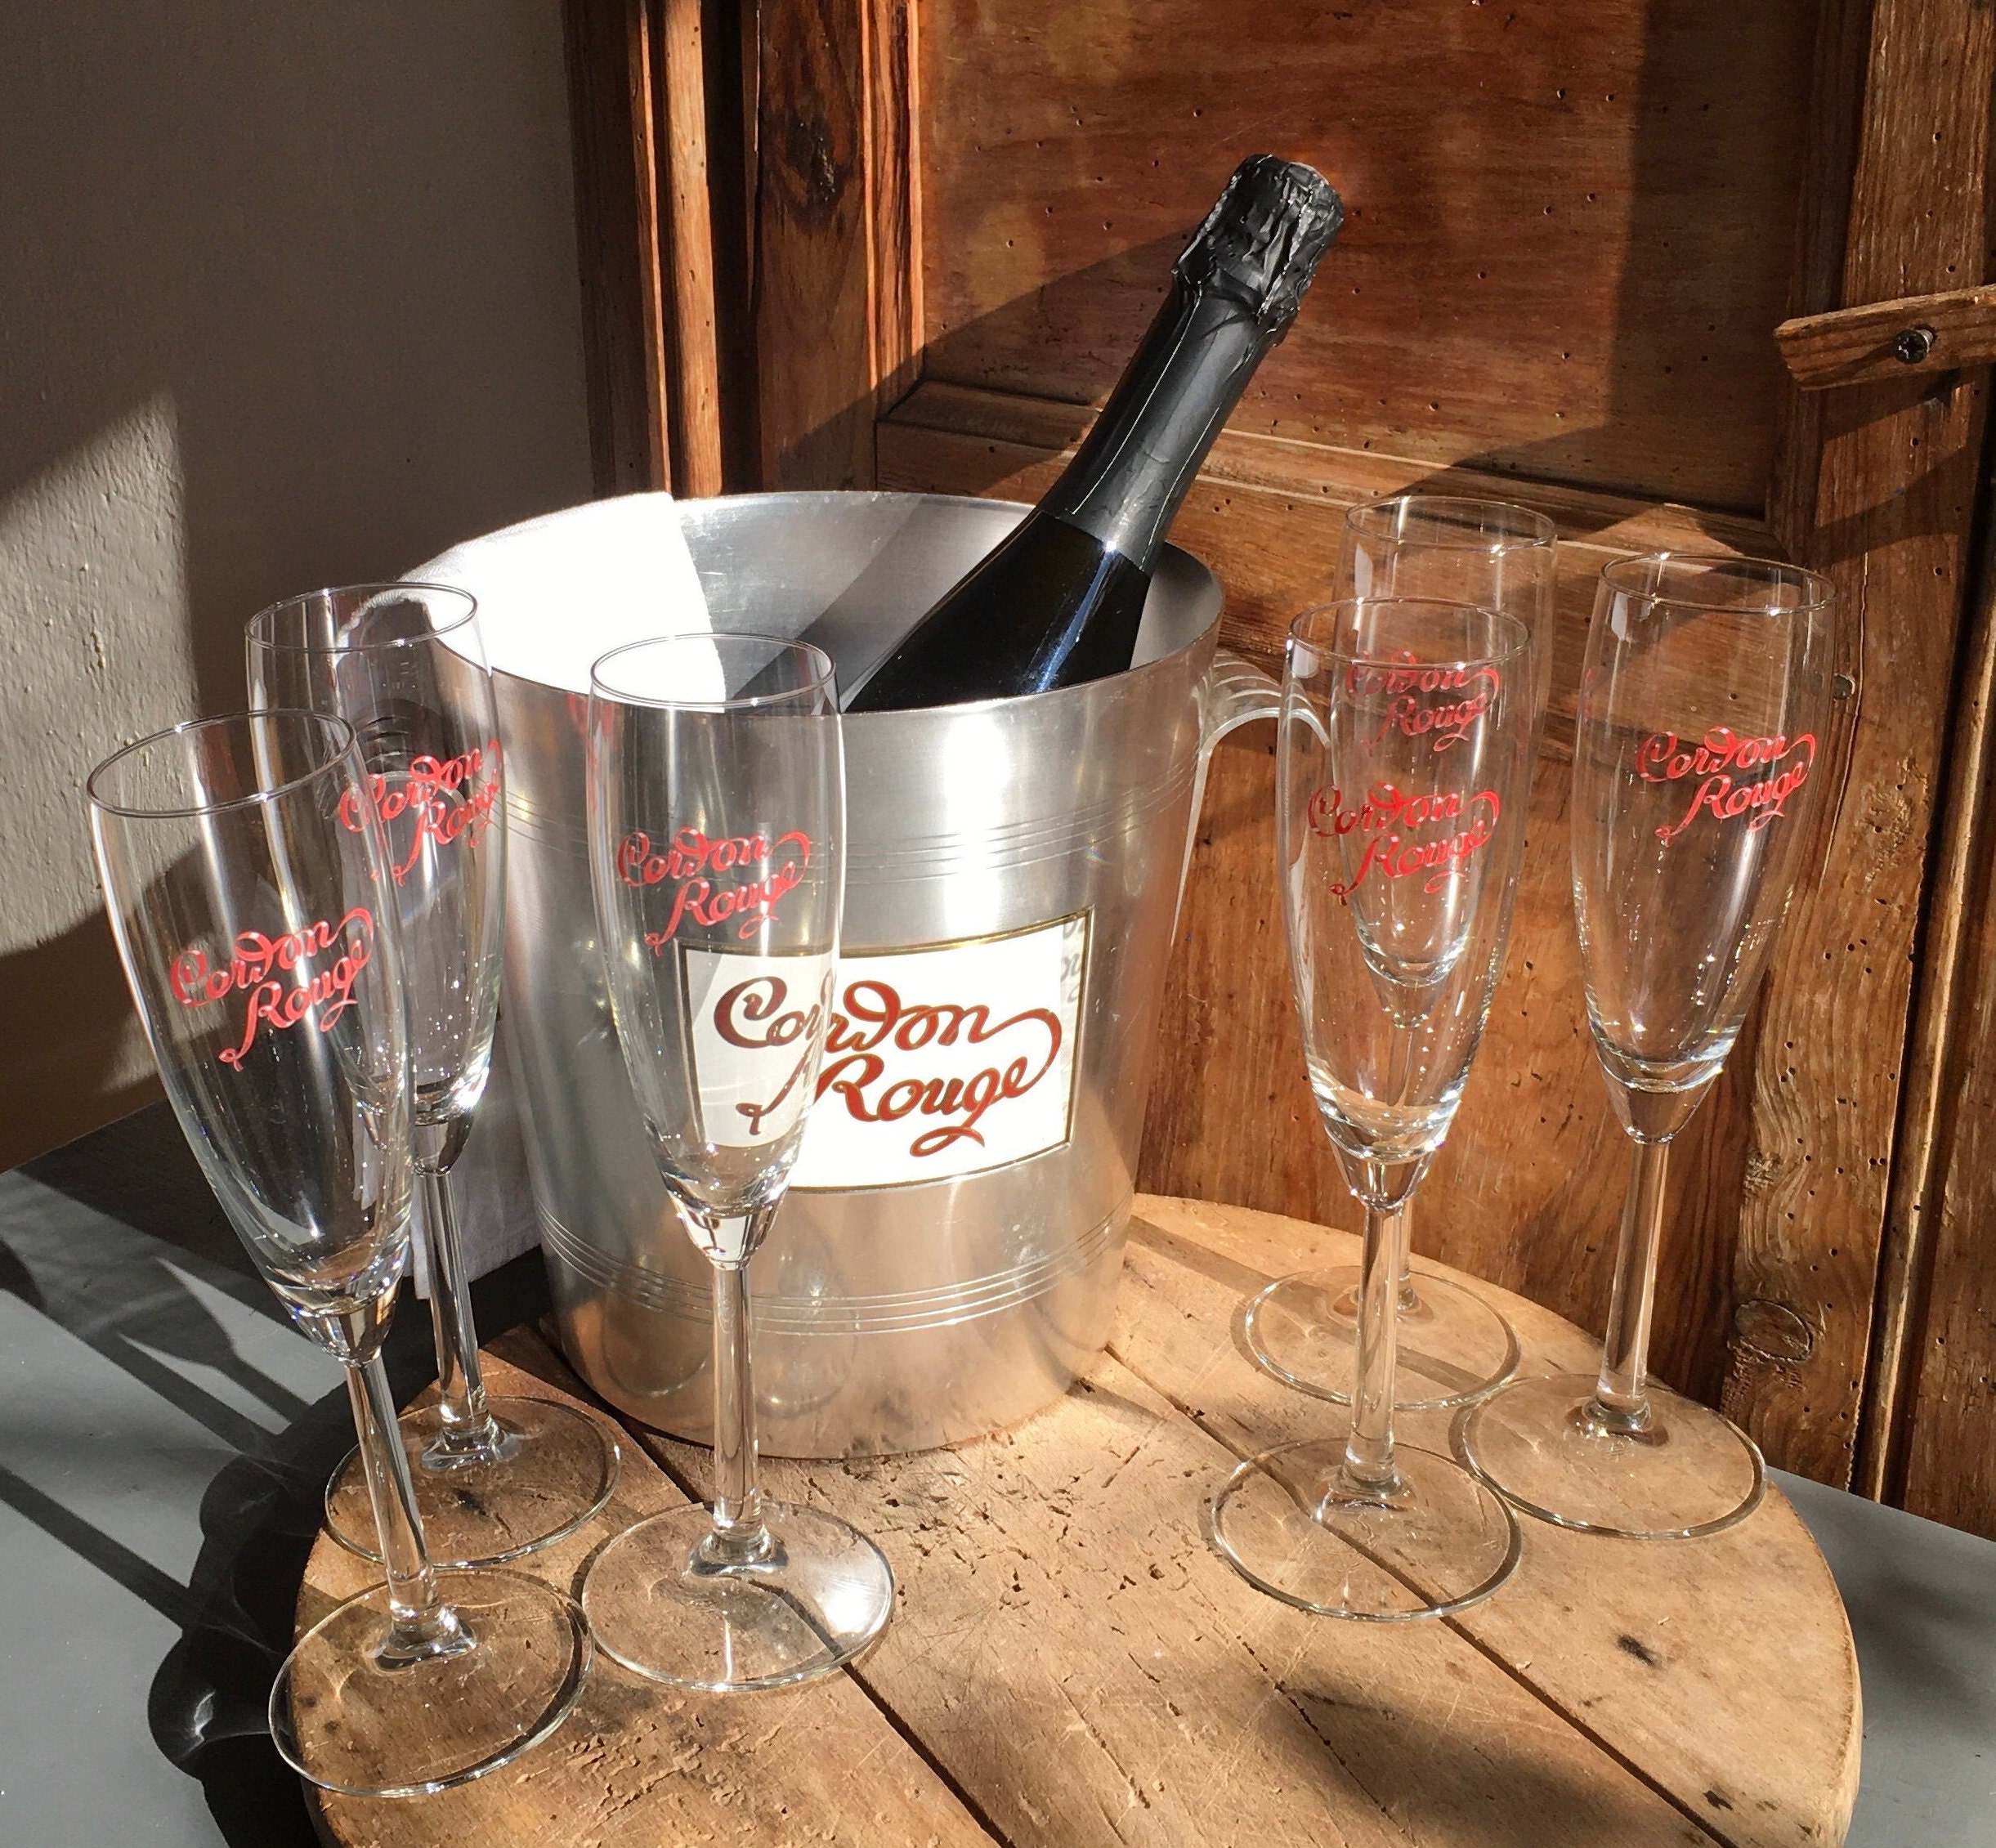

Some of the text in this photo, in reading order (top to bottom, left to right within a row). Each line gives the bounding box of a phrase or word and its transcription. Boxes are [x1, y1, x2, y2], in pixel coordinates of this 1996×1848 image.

[1636, 726, 1816, 782] Cordon
[1308, 781, 1501, 837] Cordon
[1654, 759, 1808, 848] Rouge
[617, 826, 811, 886] Cordon
[1330, 817, 1493, 905] Rouge
[644, 861, 799, 956] Rouge
[170, 907, 374, 1008] Cordon
[218, 938, 372, 1072] Rouge
[714, 976, 1063, 1054] Cordon
[736, 1053, 1031, 1157] Rouge
